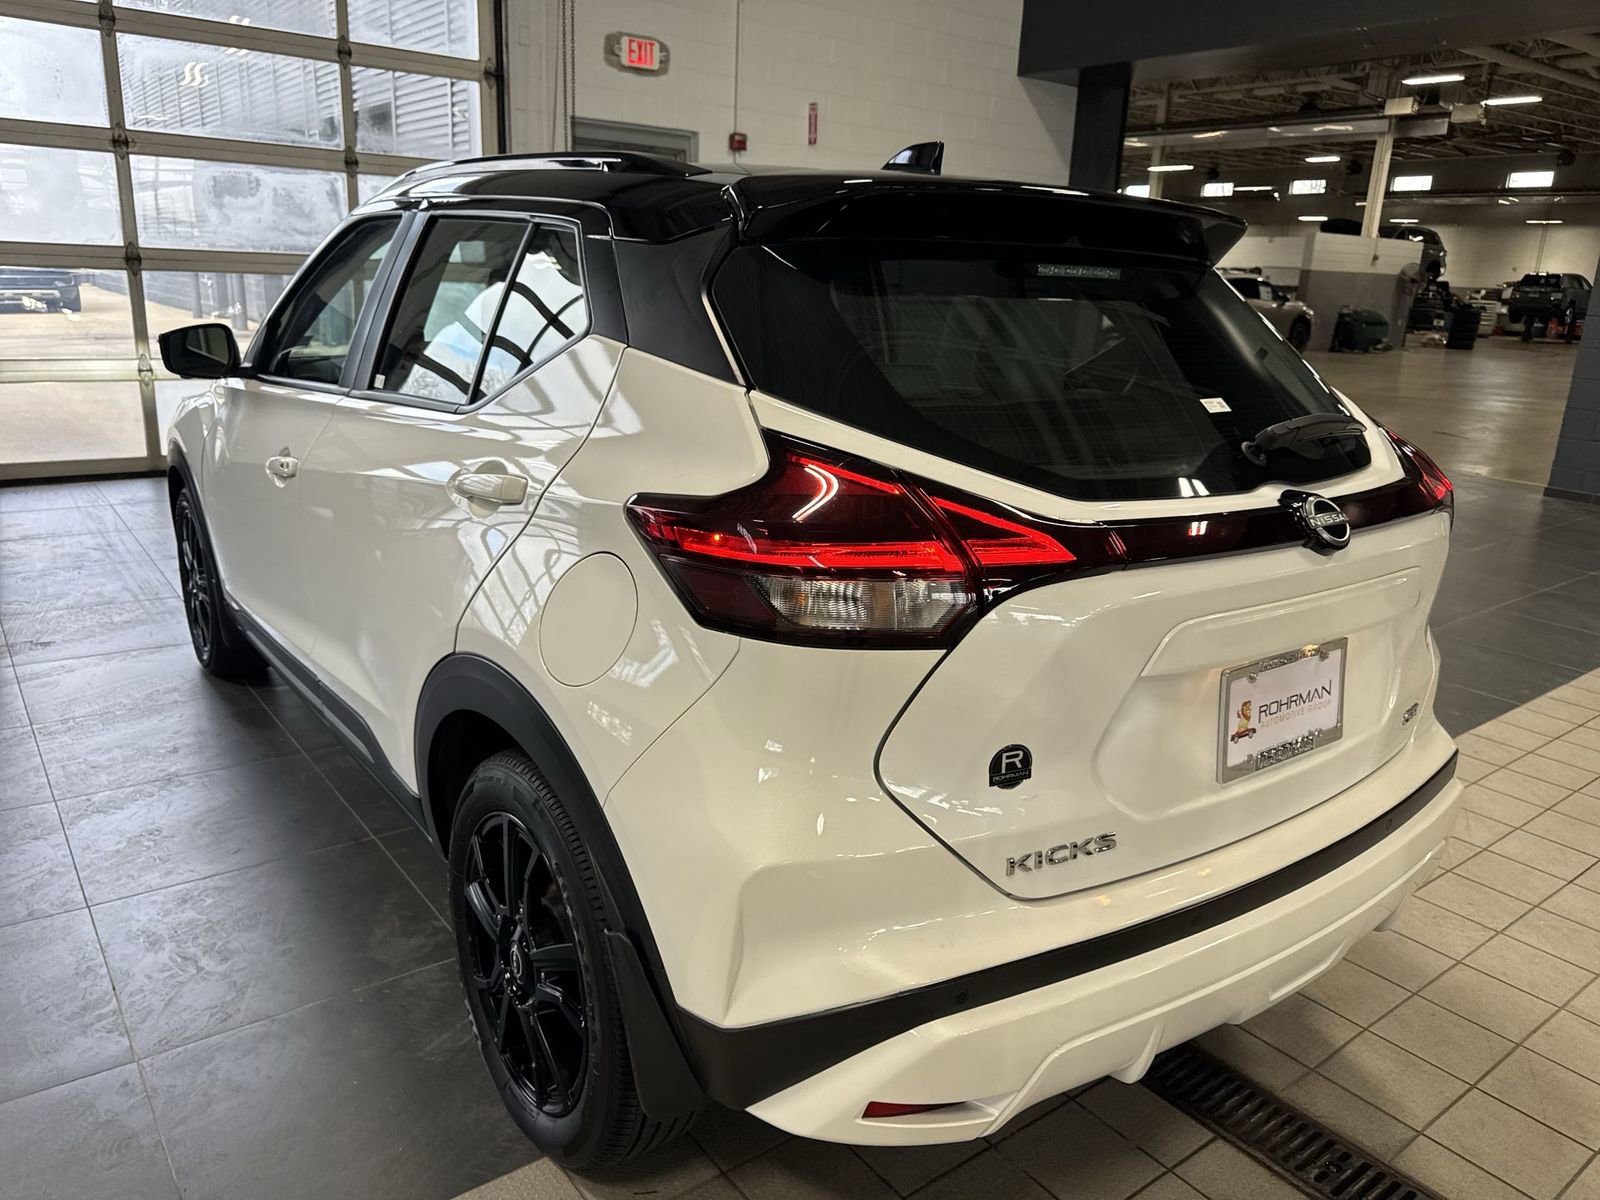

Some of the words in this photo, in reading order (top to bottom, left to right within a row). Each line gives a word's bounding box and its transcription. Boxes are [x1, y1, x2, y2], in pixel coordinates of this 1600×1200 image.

[628, 38, 656, 67] EXIT
[1310, 513, 1348, 527] NISSA
[1258, 679, 1332, 724] ROHRMAN
[1260, 707, 1305, 729] AUTOMOTIVE
[1002, 750, 1024, 774] R
[1006, 831, 1117, 877] KICKS
